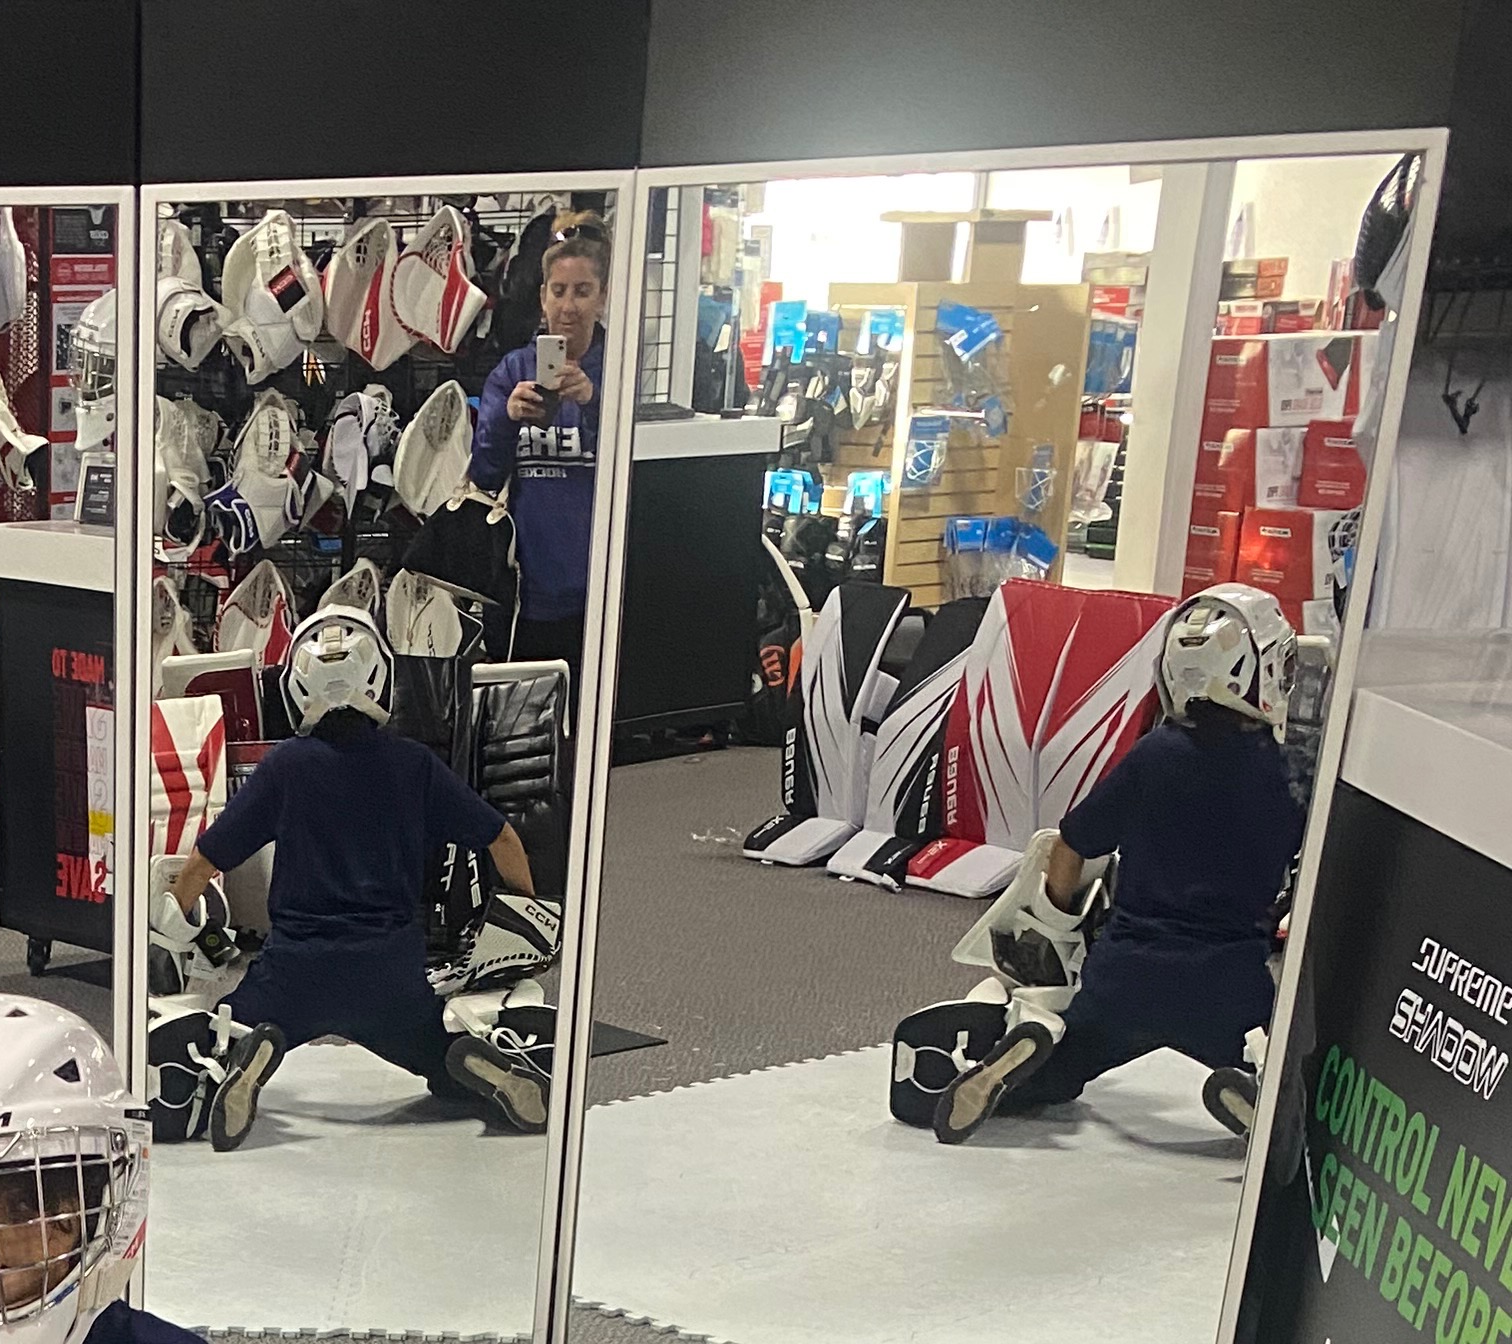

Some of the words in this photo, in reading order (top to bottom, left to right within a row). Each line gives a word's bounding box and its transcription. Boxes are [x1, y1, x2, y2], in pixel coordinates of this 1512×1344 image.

[1411, 936, 1512, 1026] SUPREME
[1389, 988, 1510, 1101] SHADOW
[1315, 1044, 1440, 1215] CONTROL
[1311, 1152, 1389, 1281] SEEN
